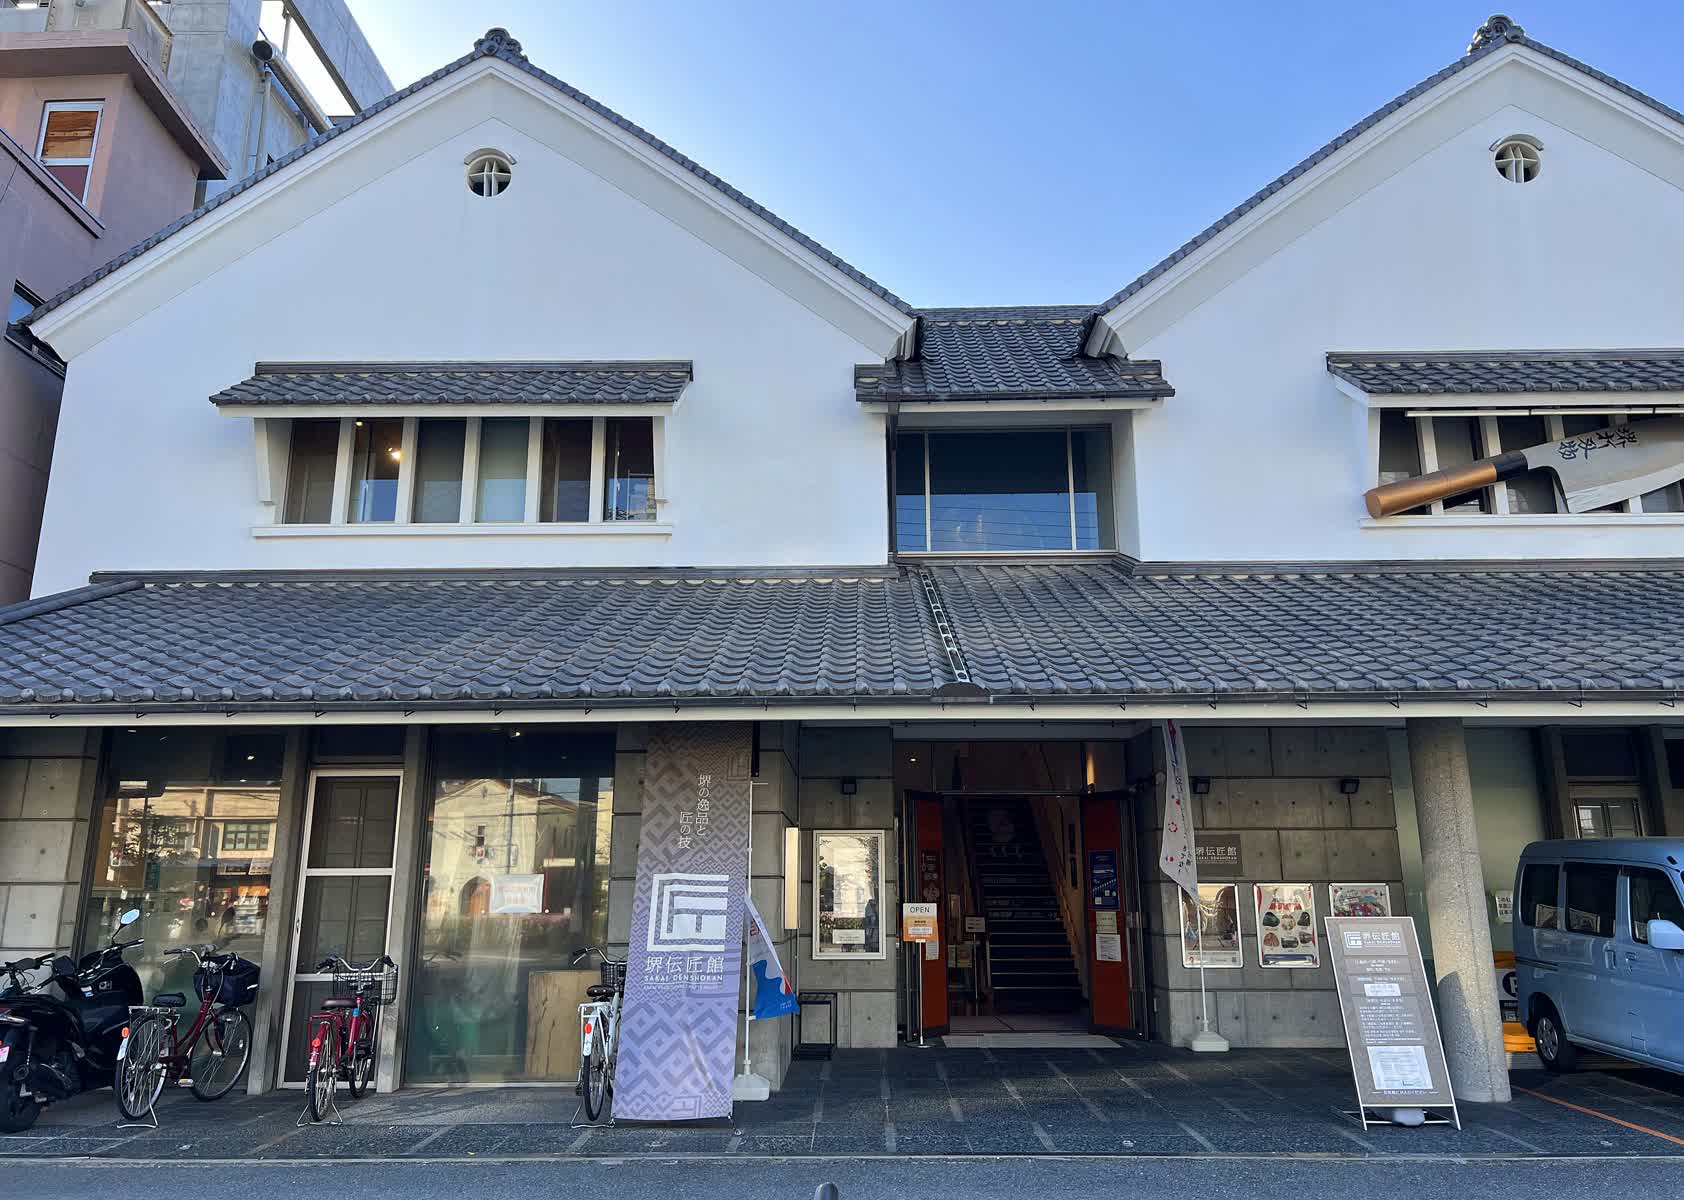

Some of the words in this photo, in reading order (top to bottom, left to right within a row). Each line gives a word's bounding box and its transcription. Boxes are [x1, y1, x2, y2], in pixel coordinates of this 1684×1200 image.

[695, 774, 711, 836] 堺の逸品と
[678, 811, 694, 849] 匠の技
[644, 956, 725, 973] 堺伝匠館
